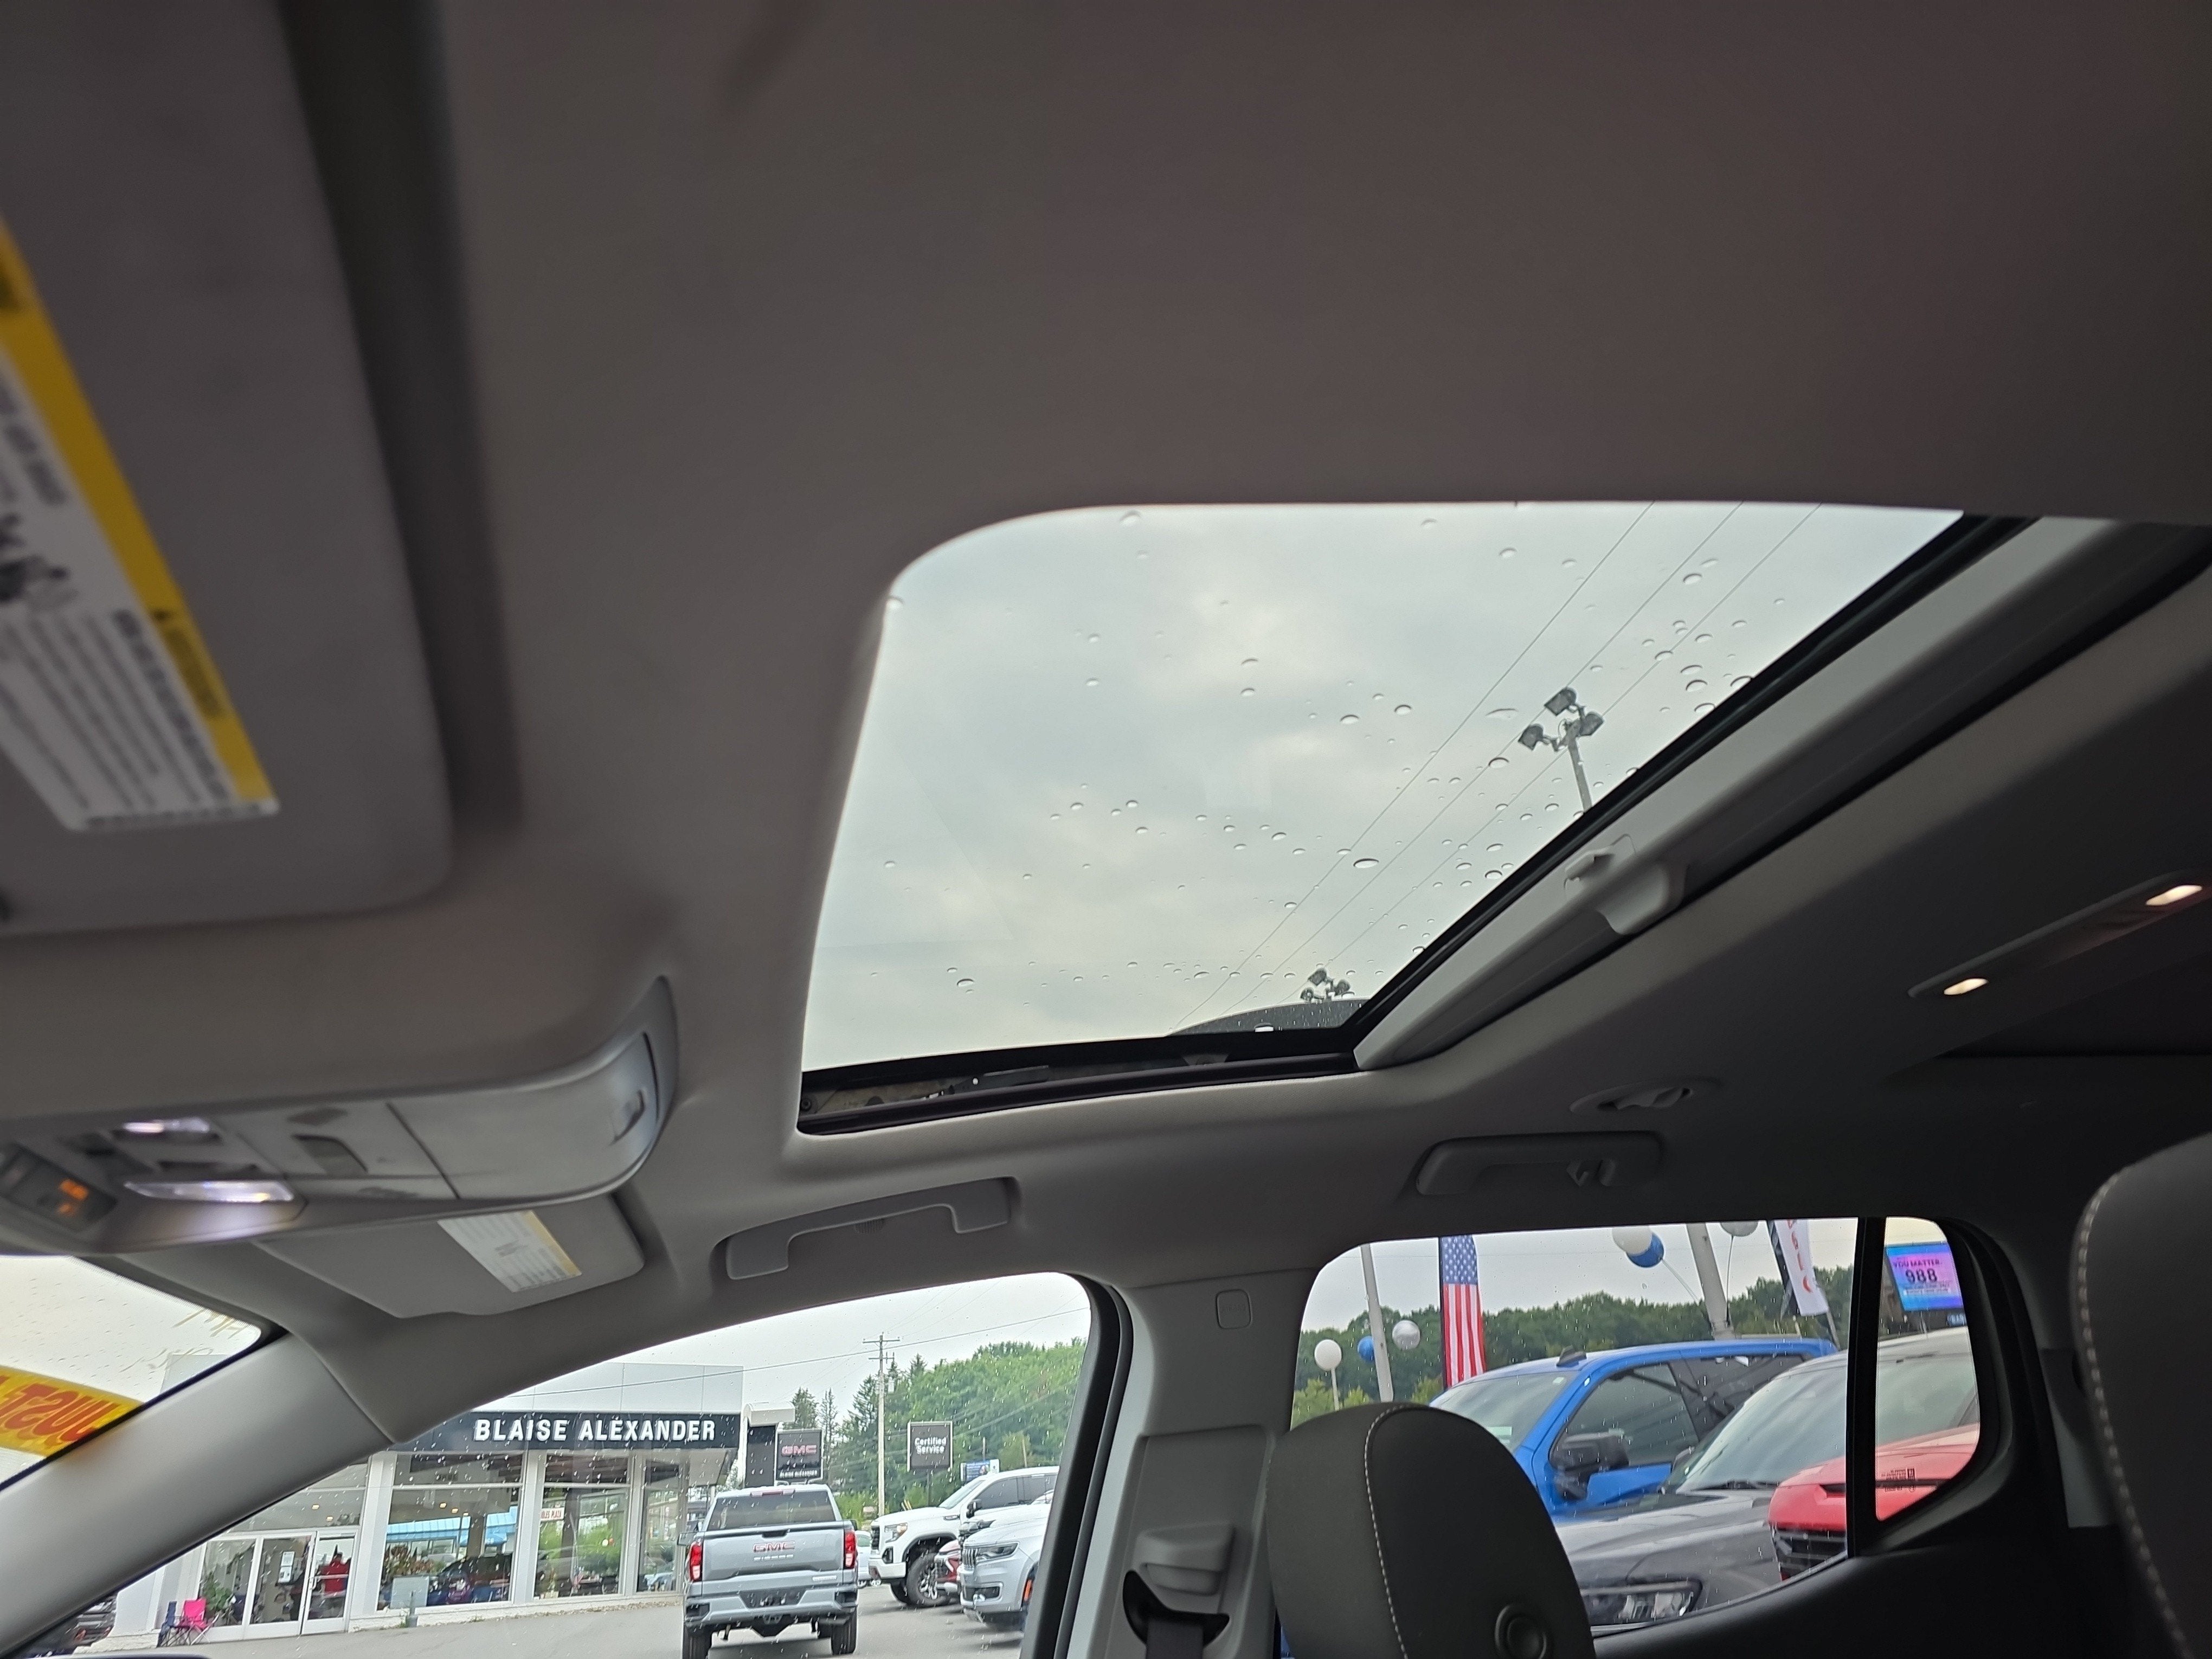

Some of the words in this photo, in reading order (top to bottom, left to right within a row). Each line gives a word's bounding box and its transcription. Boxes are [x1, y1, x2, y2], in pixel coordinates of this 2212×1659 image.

[1905, 1268, 1938, 1284] 988
[473, 1419, 569, 1442] BLAISE
[578, 1418, 715, 1441] ALEXANDER
[914, 1437, 947, 1446] Certified
[781, 1444, 816, 1457] GMC
[916, 1445, 944, 1455] Service
[753, 1541, 796, 1553] GMC
